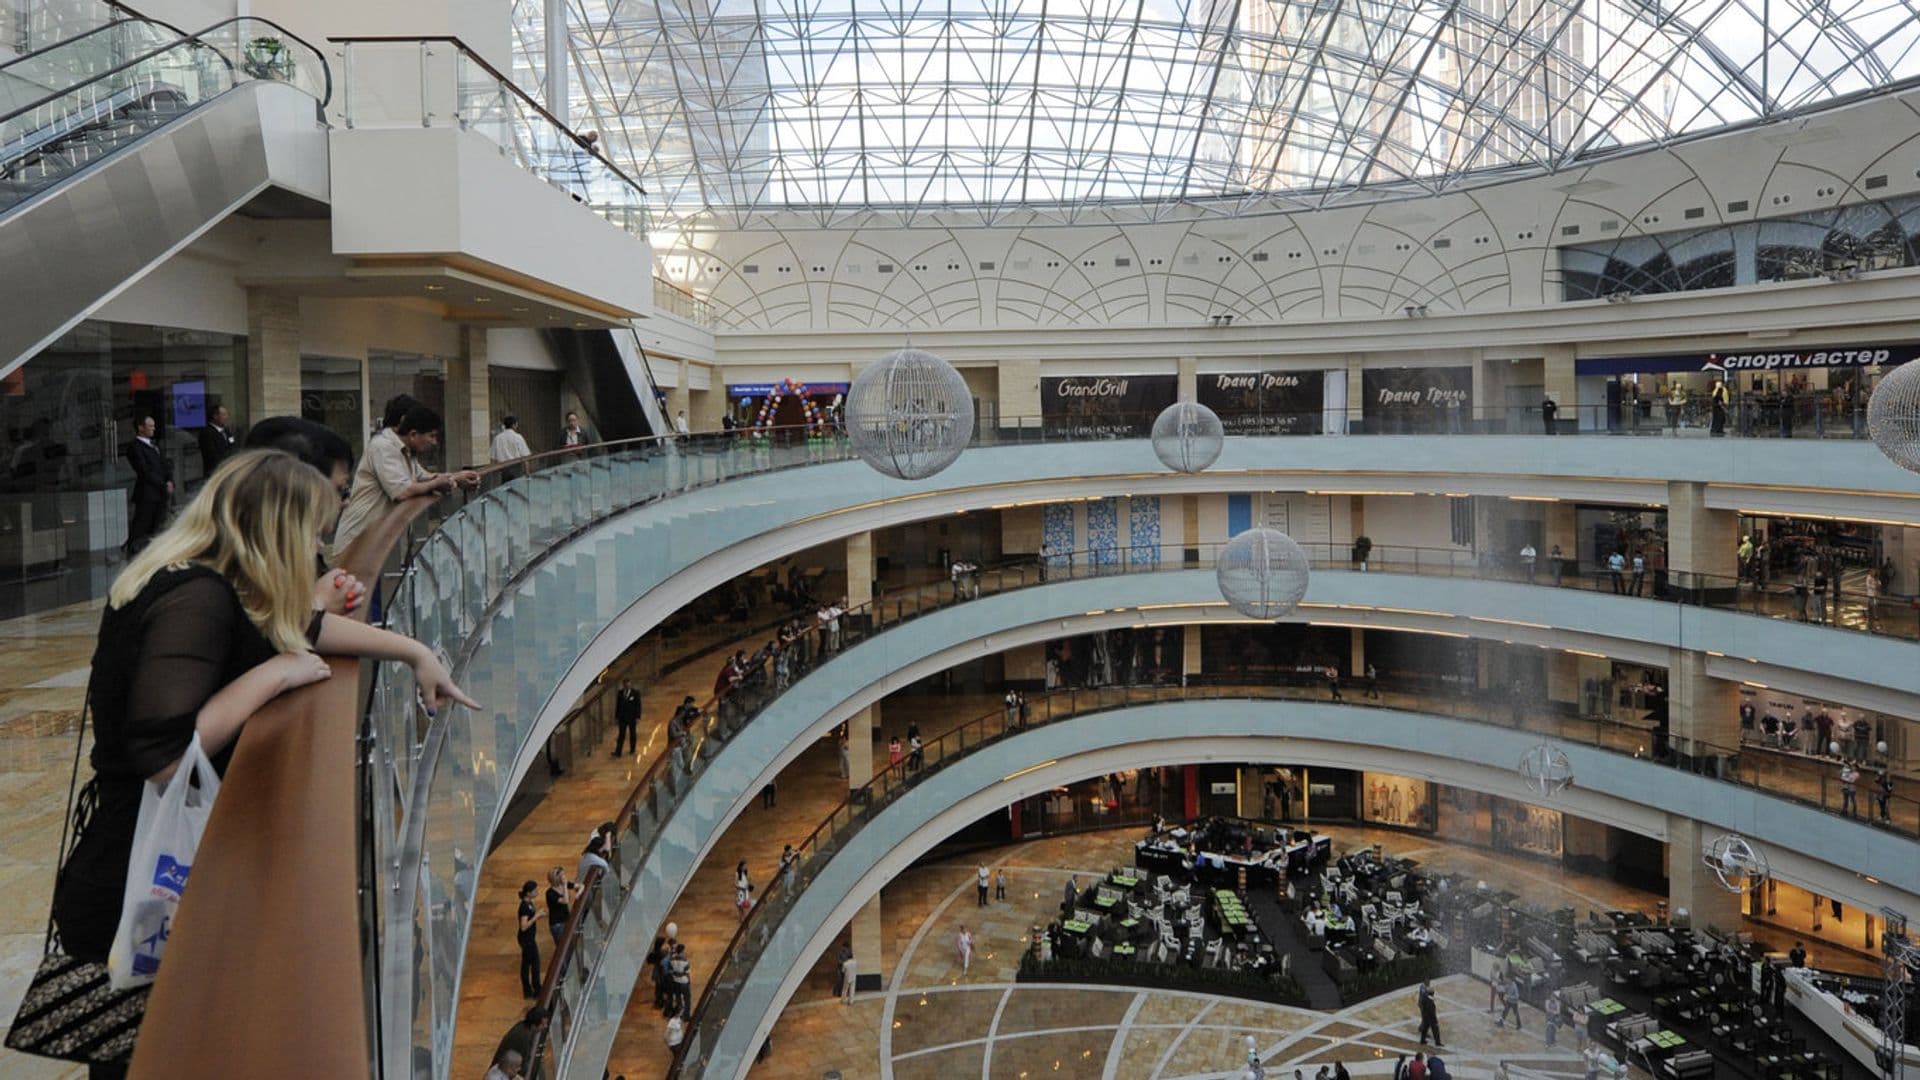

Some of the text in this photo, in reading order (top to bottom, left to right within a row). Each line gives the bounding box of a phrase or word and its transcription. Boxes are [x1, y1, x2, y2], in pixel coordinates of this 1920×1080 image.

[1723, 349, 1889, 369] спортмастер
[1058, 379, 1128, 397] GrandGrill
[1216, 374, 1299, 391] Гранд Гриль
[1378, 388, 1421, 405] Гранд
